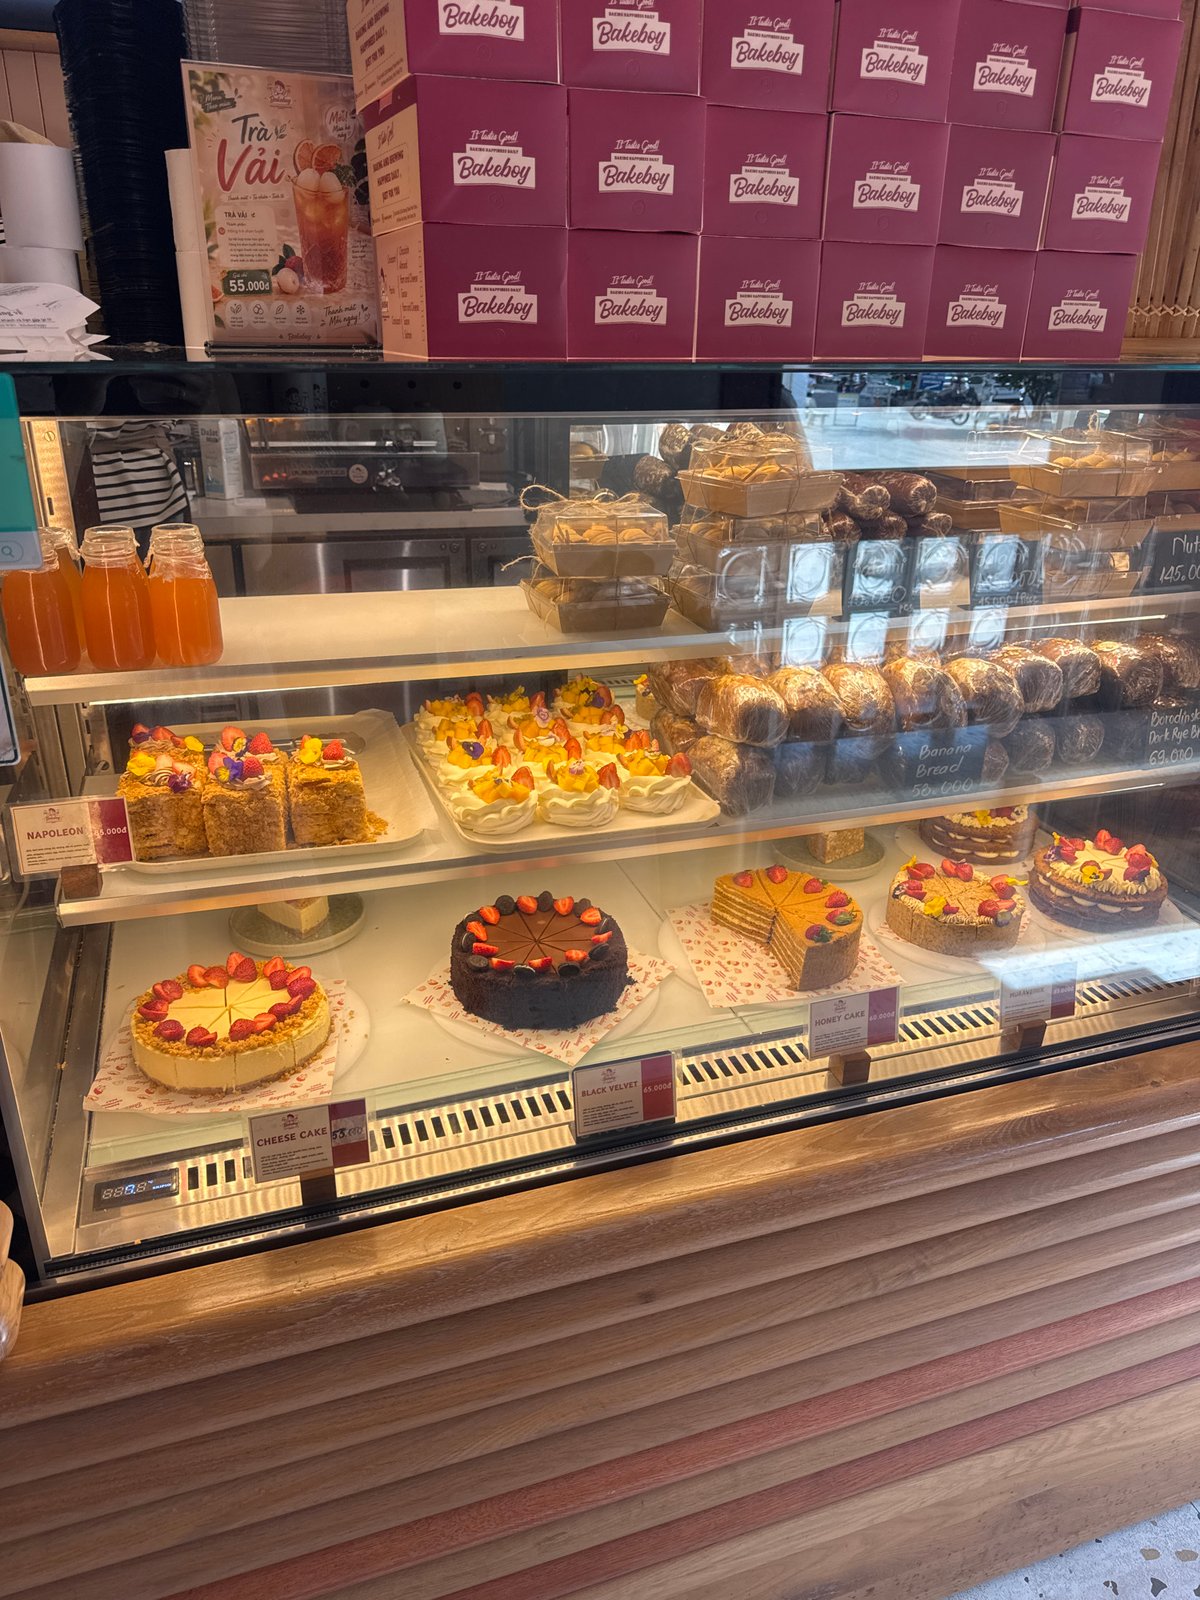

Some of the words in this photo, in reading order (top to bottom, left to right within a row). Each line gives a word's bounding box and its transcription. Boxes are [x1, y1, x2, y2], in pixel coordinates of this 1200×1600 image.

[443, 3, 520, 36] Bakeboy
[597, 21, 667, 51] Bakeboy
[735, 41, 800, 71] Bakeboy
[865, 52, 924, 81] Bakeboy
[978, 65, 1033, 93] Bakeboy
[1095, 77, 1148, 104] Bakeboy
[232, 113, 273, 144] Trà
[218, 139, 285, 192] Vải
[457, 156, 532, 185] Bakeboy
[603, 164, 671, 191] Bakeboy
[734, 177, 796, 203] Bakeboy
[858, 183, 917, 208] Bakeboy
[966, 189, 1020, 214] Bakeboy
[1076, 196, 1128, 219] Bakeboy
[462, 295, 534, 321] Bakeboy
[599, 298, 664, 322] Bakeboy
[729, 301, 789, 324] Bakeboy
[846, 303, 902, 325] Bakeboy
[951, 304, 1003, 326] Bakeboy
[1053, 309, 1104, 330] Bakeboy
[1149, 728, 1170, 745] Dark
[1171, 726, 1189, 745] Rye
[919, 744, 973, 761] Banana
[915, 755, 964, 778] Bread
[27, 826, 84, 841] NAPOLEON
[815, 1013, 842, 1026] HONEY
[844, 1010, 866, 1021] CAKE
[581, 1087, 607, 1098] BLACK
[609, 1080, 639, 1093] VELVET
[256, 1132, 297, 1147] CHEESE
[299, 1127, 328, 1139] CAKE
